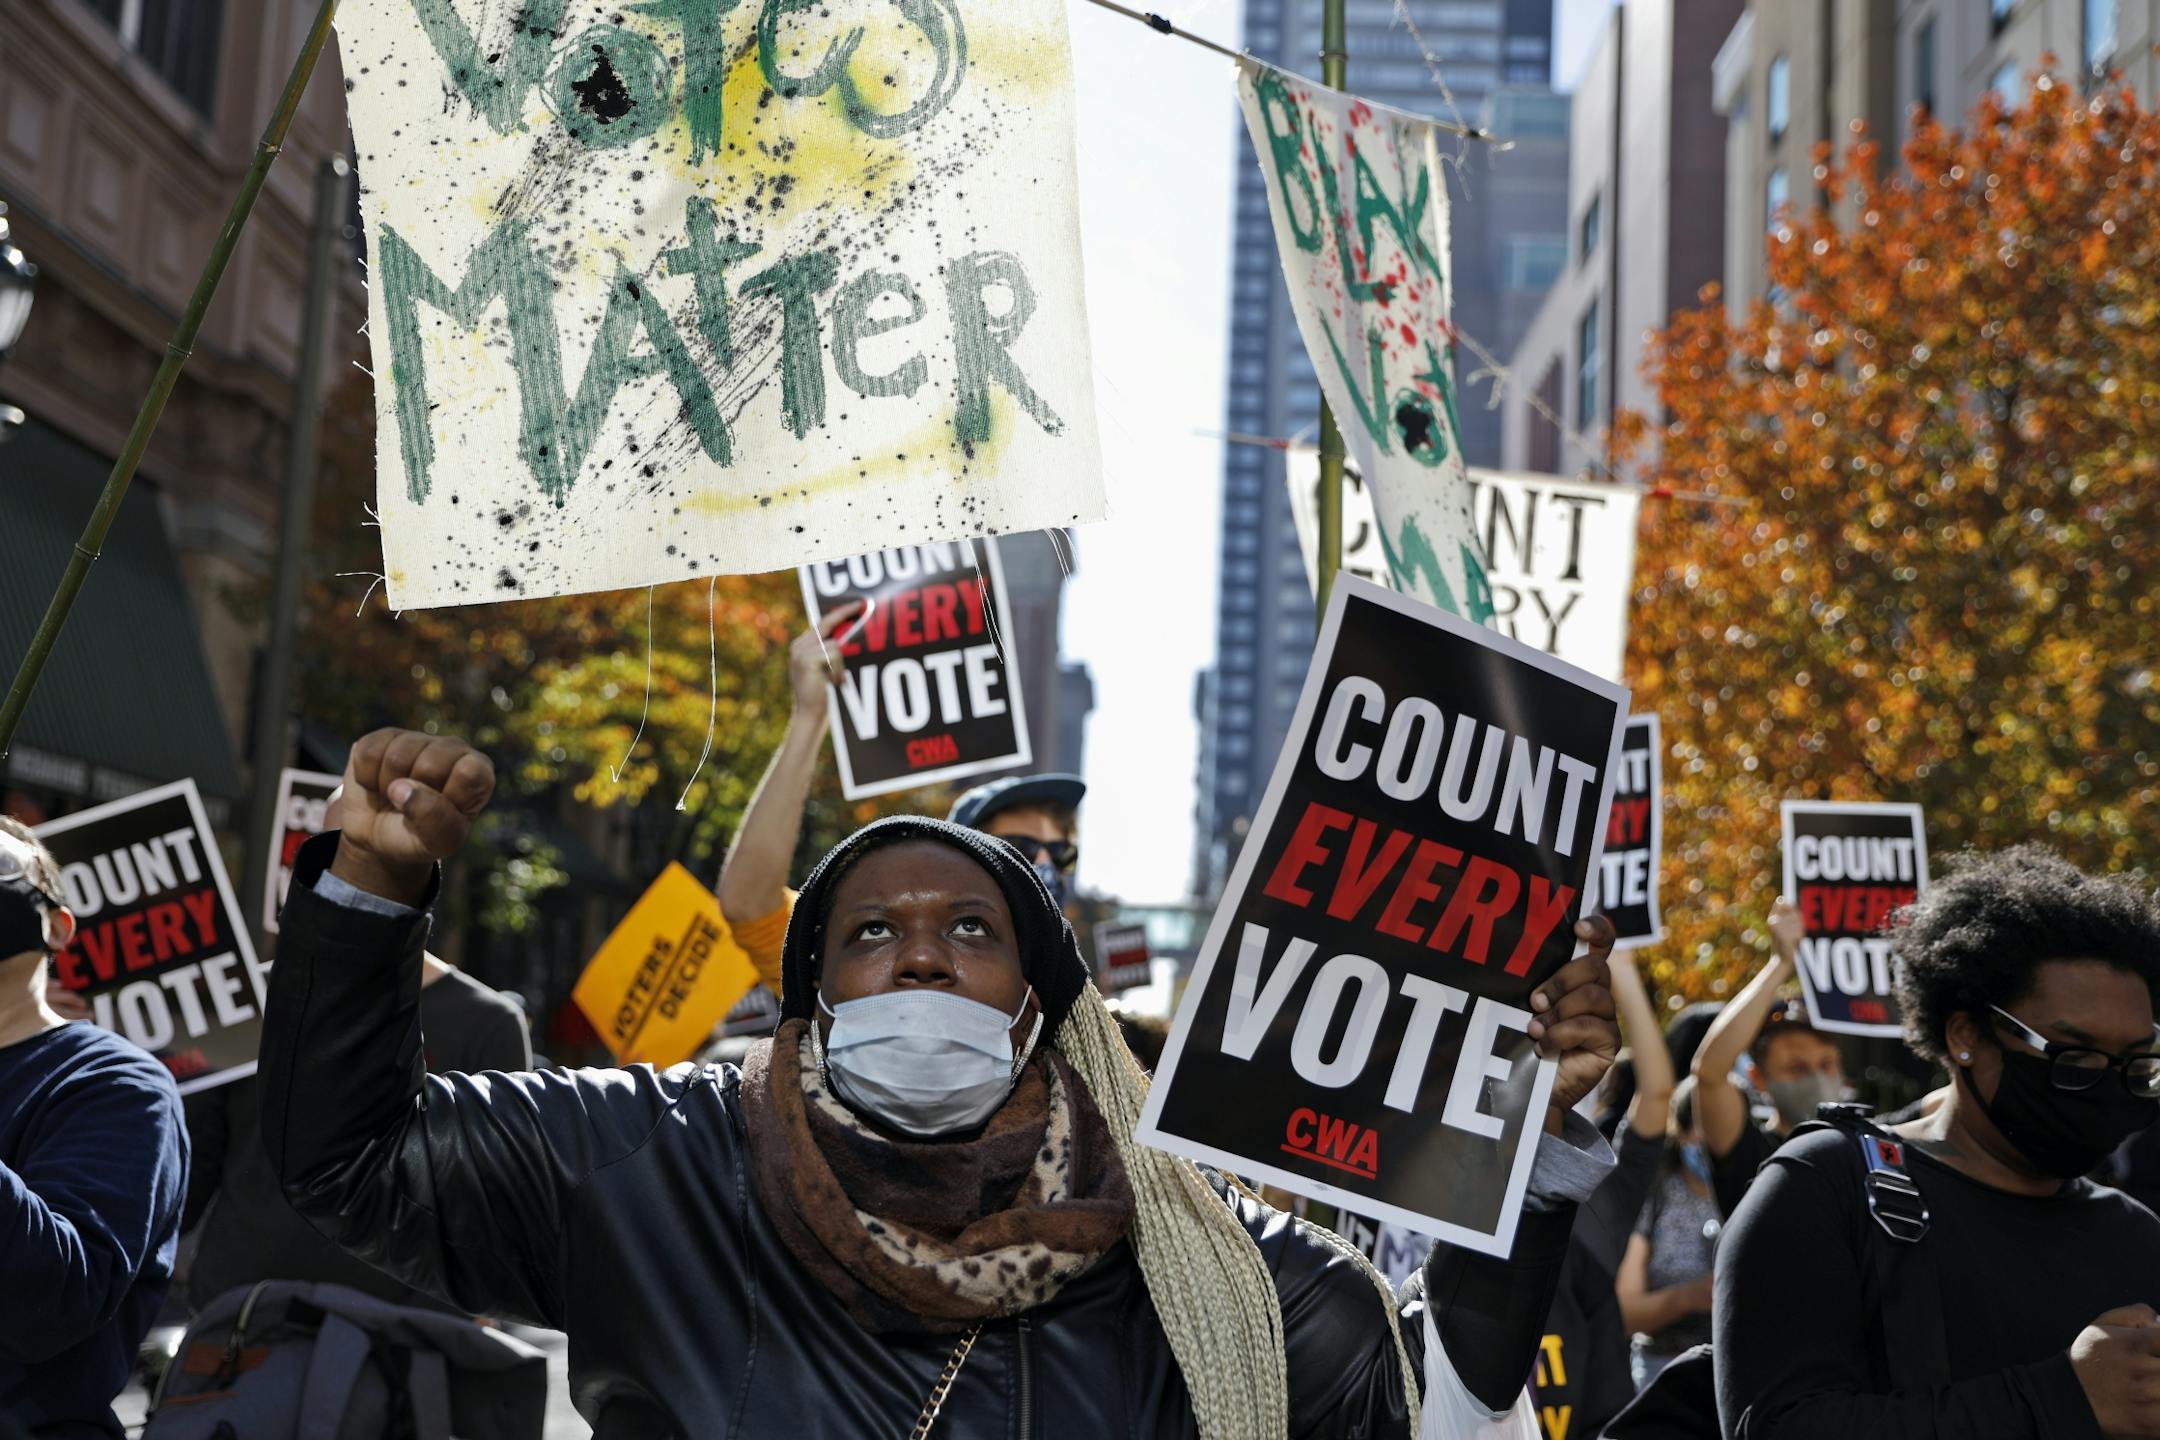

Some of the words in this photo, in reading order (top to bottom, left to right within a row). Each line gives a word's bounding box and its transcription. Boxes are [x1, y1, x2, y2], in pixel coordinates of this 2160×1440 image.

[840, 643, 1006, 741] VOTE
[1314, 675, 1596, 857] COUNT
[62, 827, 201, 918] OUNT
[1262, 801, 1576, 977] EVERY
[1795, 834, 1915, 882] COUNT
[56, 890, 217, 990] EVERY
[614, 932, 673, 1040] VOTERS
[657, 920, 722, 1020] DECIDE
[1220, 922, 1536, 1141] VOTE
[1286, 1107, 1377, 1173] CWA
